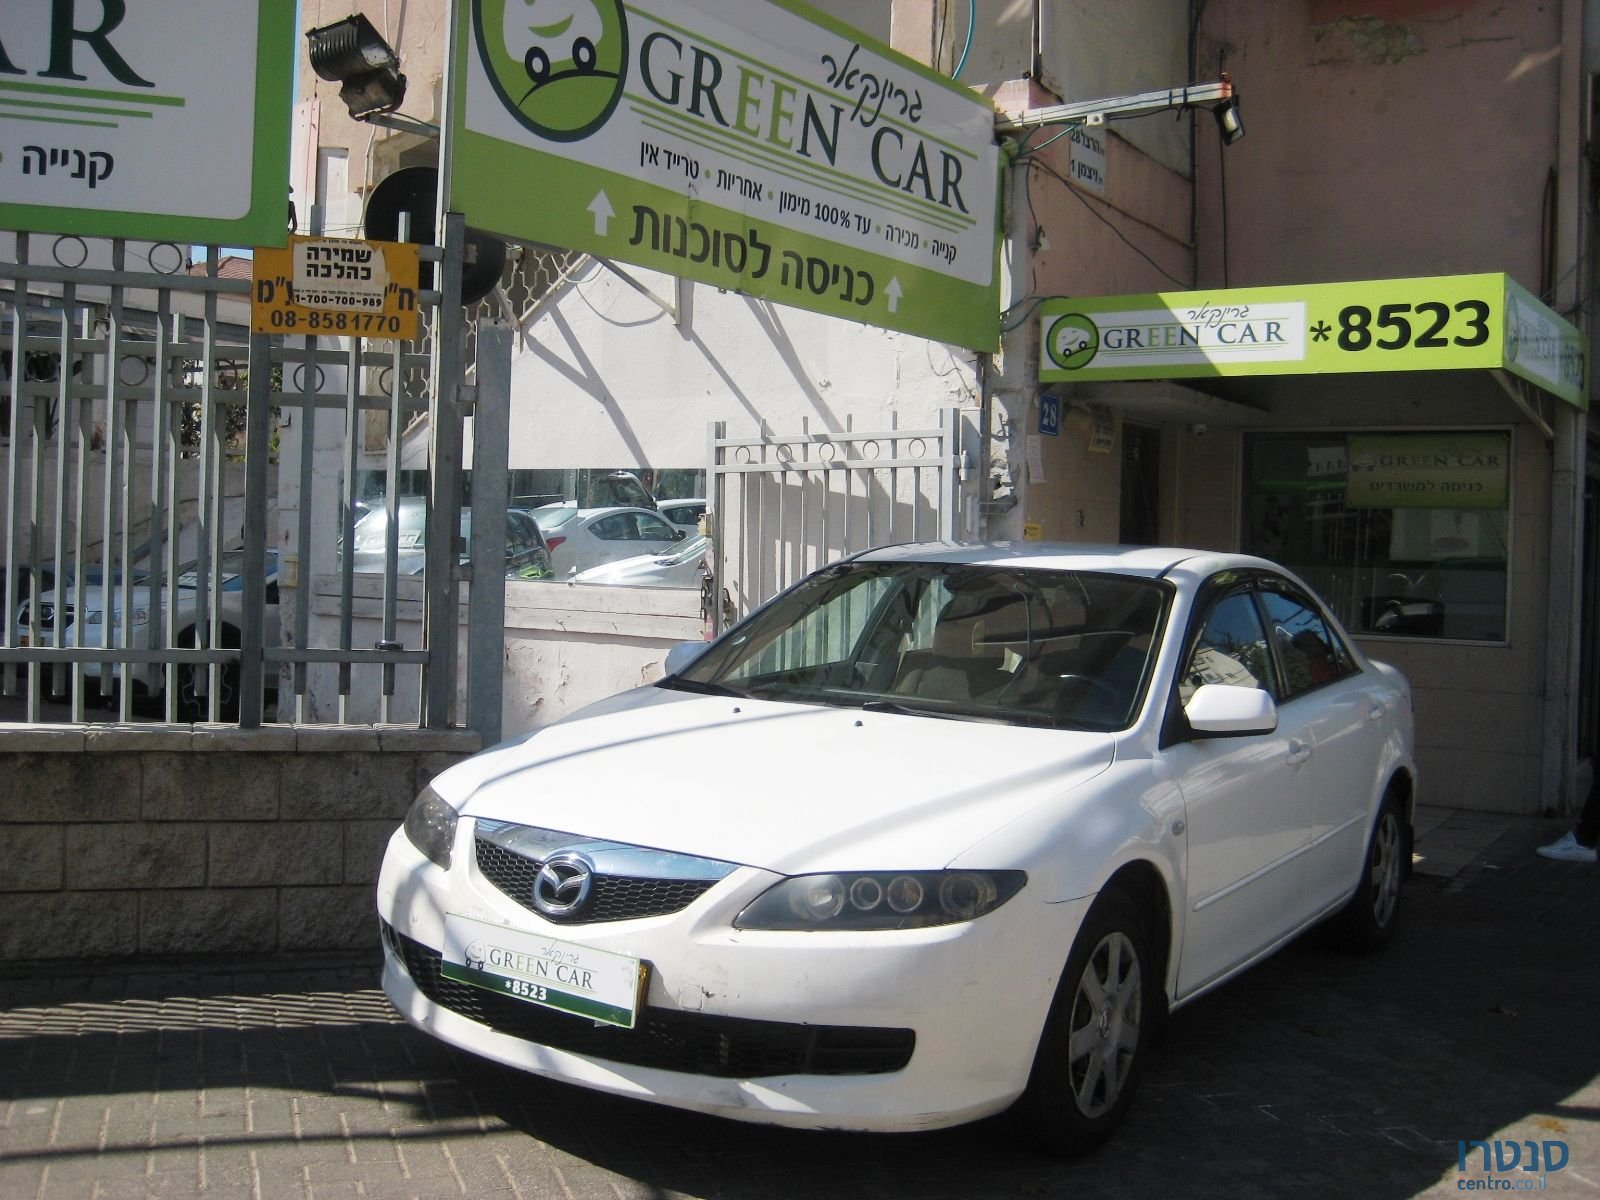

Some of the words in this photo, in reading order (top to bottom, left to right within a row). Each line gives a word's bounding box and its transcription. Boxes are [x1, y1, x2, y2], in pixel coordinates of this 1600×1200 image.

[0, 0, 155, 88] R
[821, 44, 922, 127] גרינקאר
[640, 32, 844, 167] GREEN
[871, 126, 969, 214] CAR
[23, 145, 114, 189] קנייה
[641, 141, 659, 167] אין
[663, 149, 699, 179] טרייד
[717, 169, 763, 201] אחריות
[779, 191, 810, 216] מימון
[814, 202, 850, 229] 100%
[854, 215, 871, 235] עד
[886, 225, 919, 249] מכירה
[306, 246, 371, 263] שמירה
[629, 205, 771, 279] לסוכנות
[932, 240, 957, 265] קנייה
[306, 263, 371, 281] כהלכה
[781, 251, 874, 306] כניסה
[295, 294, 382, 307] 1-700-700-989
[271, 310, 400, 333] 08-8581770
[1187, 301, 1250, 328] גרינקאר
[1104, 325, 1199, 349] GREEN
[1217, 321, 1286, 344] CAR
[1042, 402, 1057, 427] 28
[1457, 455, 1499, 467] CAR
[1370, 480, 1435, 492] למשרדים
[1440, 481, 1482, 492] כניסה
[490, 948, 549, 976] GREEN
[556, 965, 592, 989] CAR
